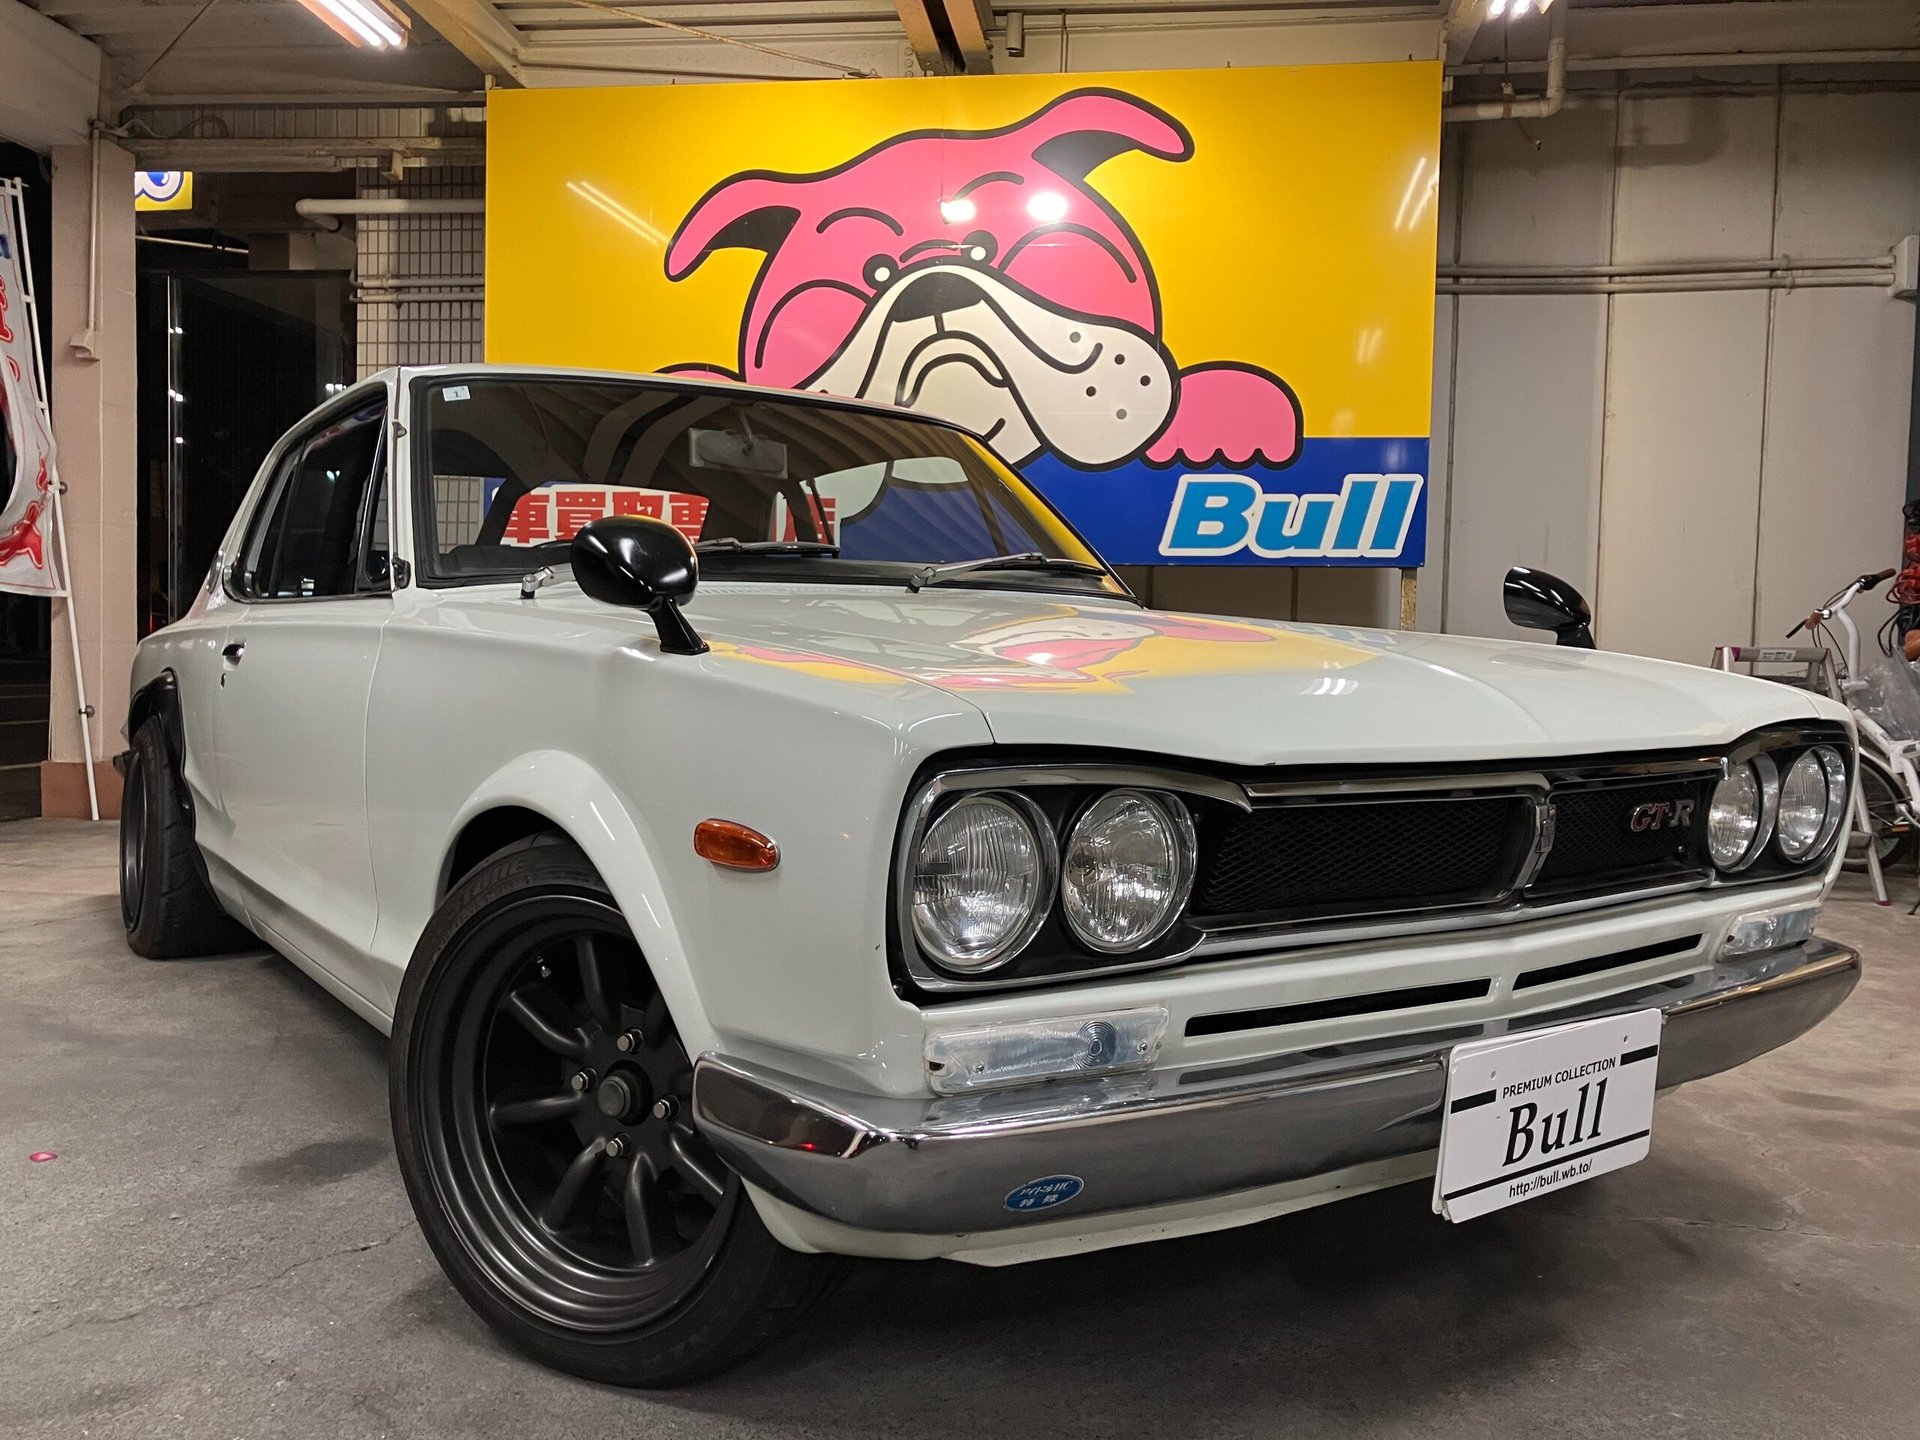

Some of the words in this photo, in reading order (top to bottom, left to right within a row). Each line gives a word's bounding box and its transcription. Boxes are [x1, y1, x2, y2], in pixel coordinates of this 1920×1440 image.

[1159, 474, 1423, 558] Bull
[1630, 800, 1695, 832] GT-R
[1503, 1075, 1552, 1099] PREMIUM
[1555, 1057, 1616, 1084] COLLECTION
[1502, 1077, 1608, 1167] Bull
[1509, 1159, 1593, 1198] http://bull.wb.to/
